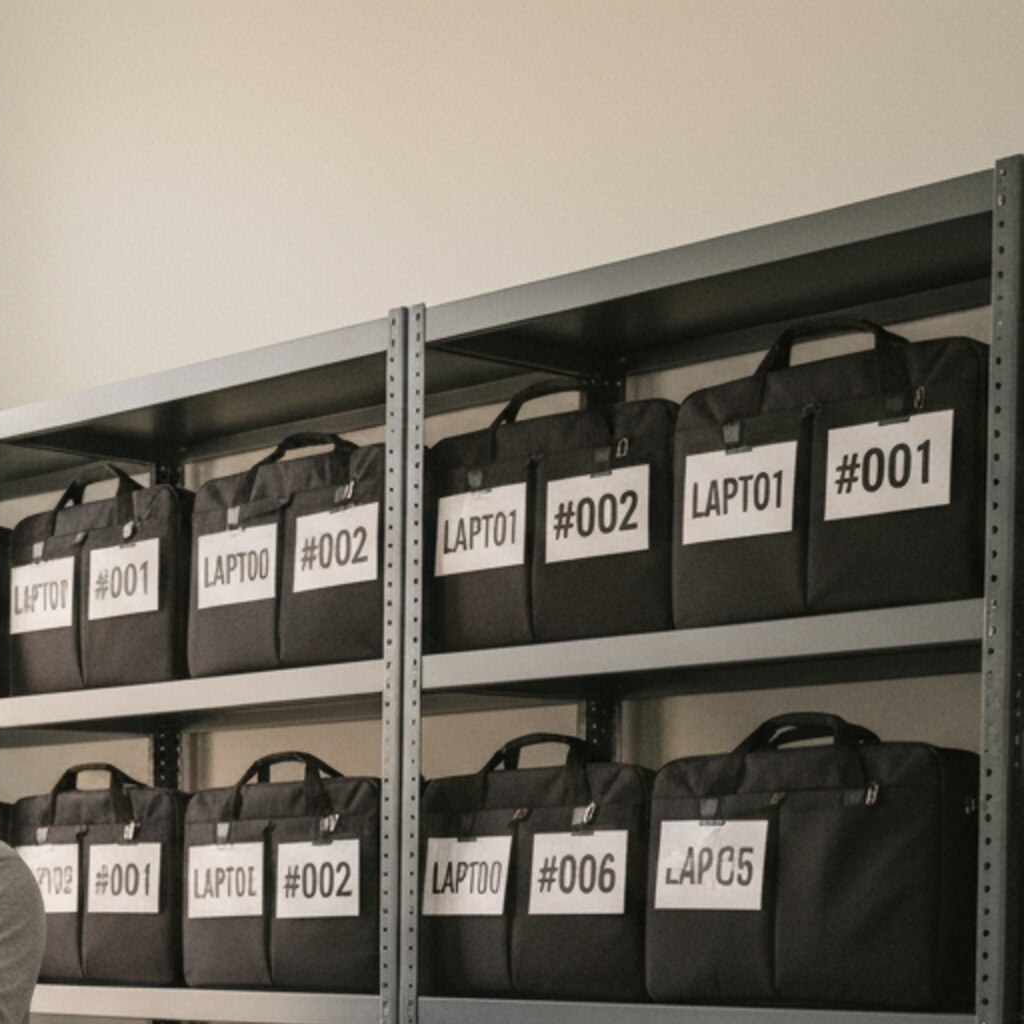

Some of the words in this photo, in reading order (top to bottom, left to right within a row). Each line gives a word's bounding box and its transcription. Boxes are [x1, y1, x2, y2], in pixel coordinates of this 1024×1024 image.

[835, 438, 932, 495] #001
[553, 489, 639, 539] #002
[300, 525, 369, 572] #002
[94, 560, 150, 600] #001
[95, 862, 152, 897] #001
[284, 861, 353, 899] #002
[538, 853, 617, 894] #006
